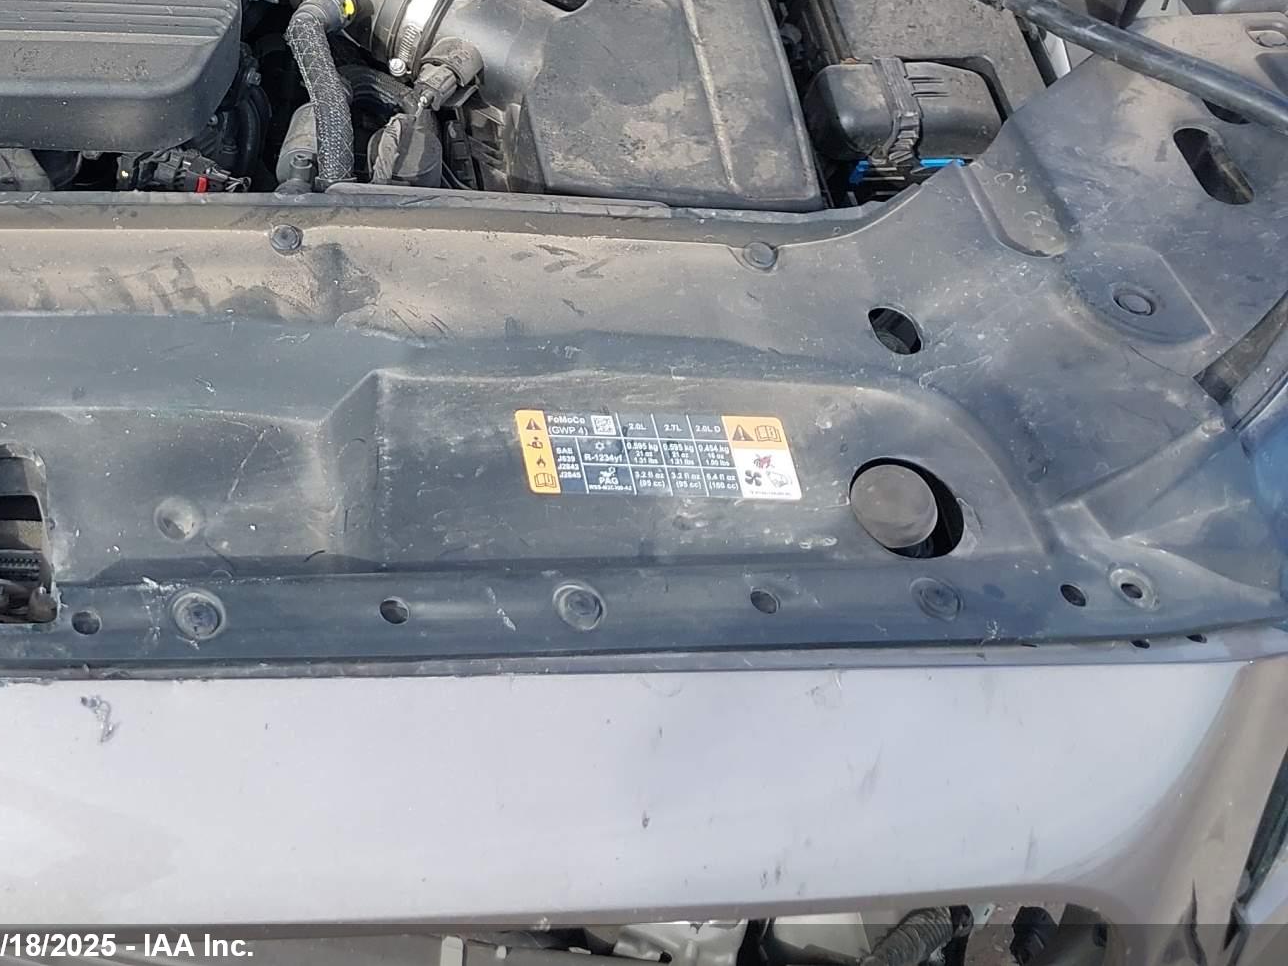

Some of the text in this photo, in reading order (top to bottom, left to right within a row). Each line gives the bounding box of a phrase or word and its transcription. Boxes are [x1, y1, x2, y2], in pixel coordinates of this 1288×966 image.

[547, 415, 585, 424] FoMoCo
[548, 426, 588, 436] (GWP 4)
[628, 423, 647, 431] 2.0L
[663, 424, 682, 432] 2.7L
[648, 442, 659, 452] kg
[685, 444, 695, 453] kg
[719, 445, 730, 454] kg
[599, 477, 619, 485] PAG
[653, 480, 665, 488] cc)
[689, 481, 702, 489] cc)
[727, 482, 739, 490] cc)
